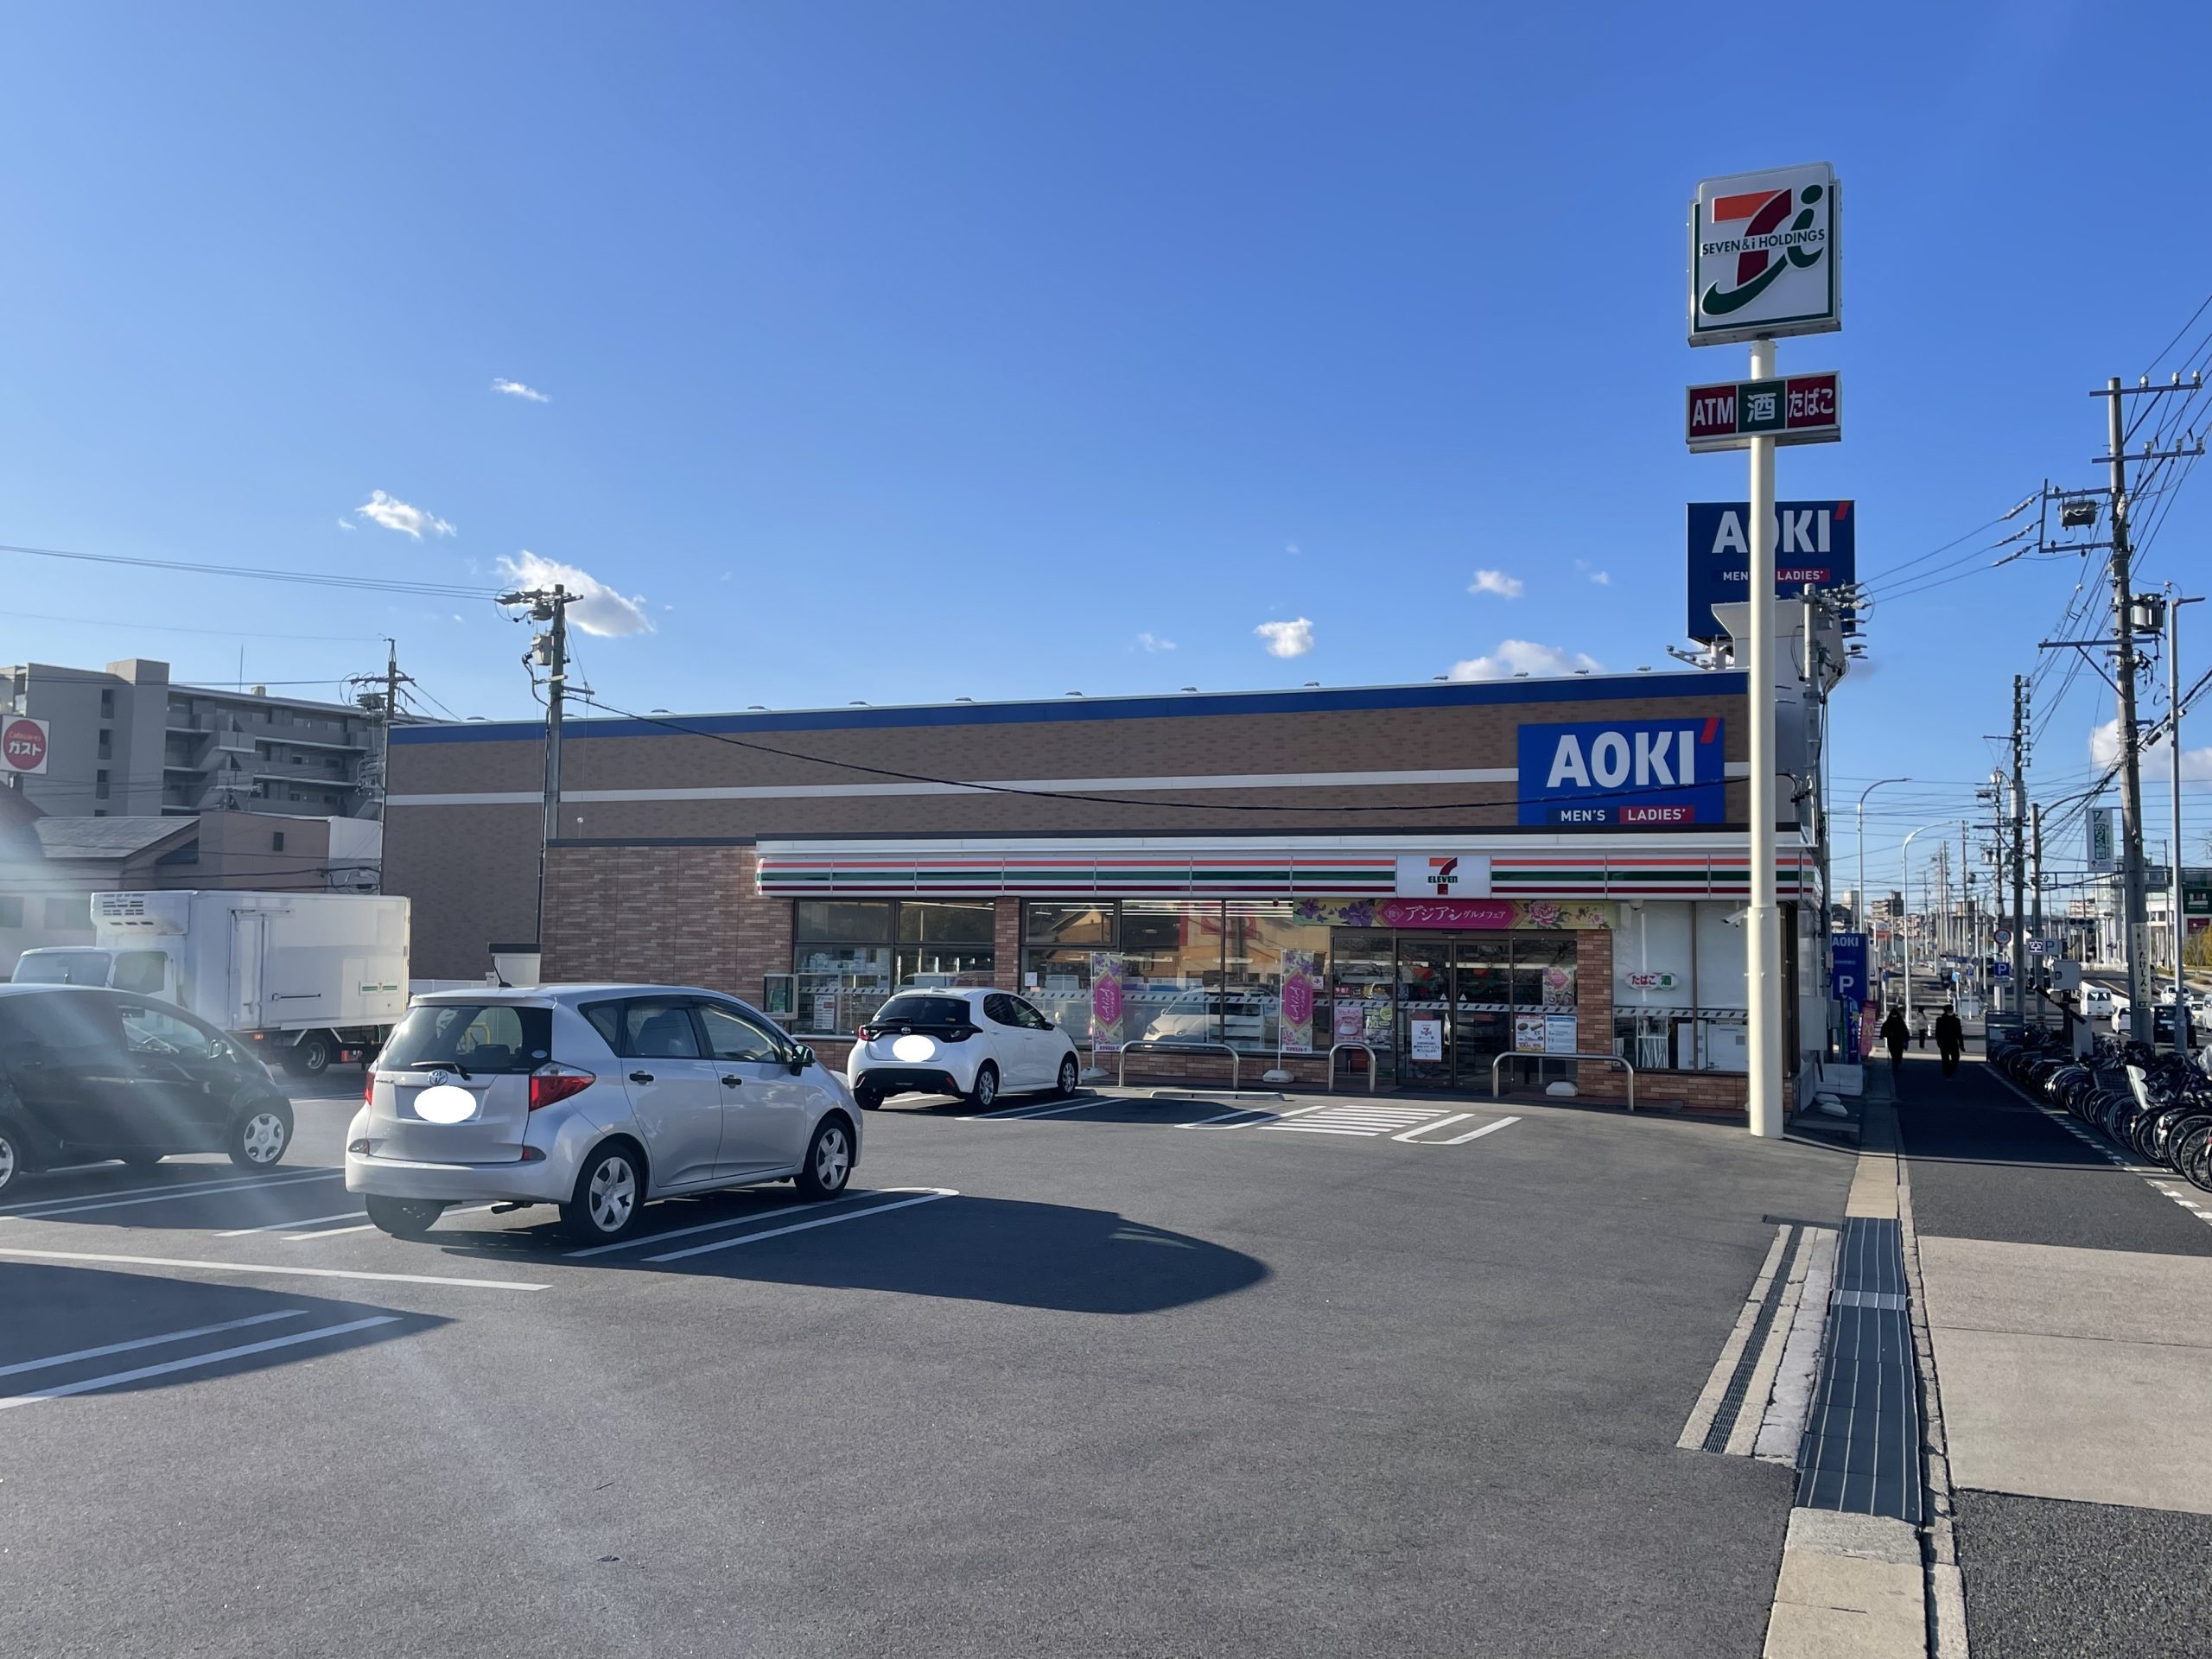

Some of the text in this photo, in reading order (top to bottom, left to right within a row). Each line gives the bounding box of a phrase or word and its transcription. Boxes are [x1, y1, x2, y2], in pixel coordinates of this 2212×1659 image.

[1758, 228, 1825, 248] HOLDINGS
[1692, 397, 1734, 426] ATM
[1747, 392, 1777, 423] 酒
[1789, 388, 1834, 418] たばこ
[1712, 510, 1830, 553] AKI
[9, 741, 41, 756] ガスト
[1547, 731, 1695, 788] AOKI
[1560, 810, 1605, 822] MEN'S
[1832, 937, 1859, 947] AOKI
[2029, 940, 2055, 952] 空 P
[1998, 963, 2007, 975] P
[1631, 975, 1656, 985] たばこ
[1840, 976, 1854, 994] P
